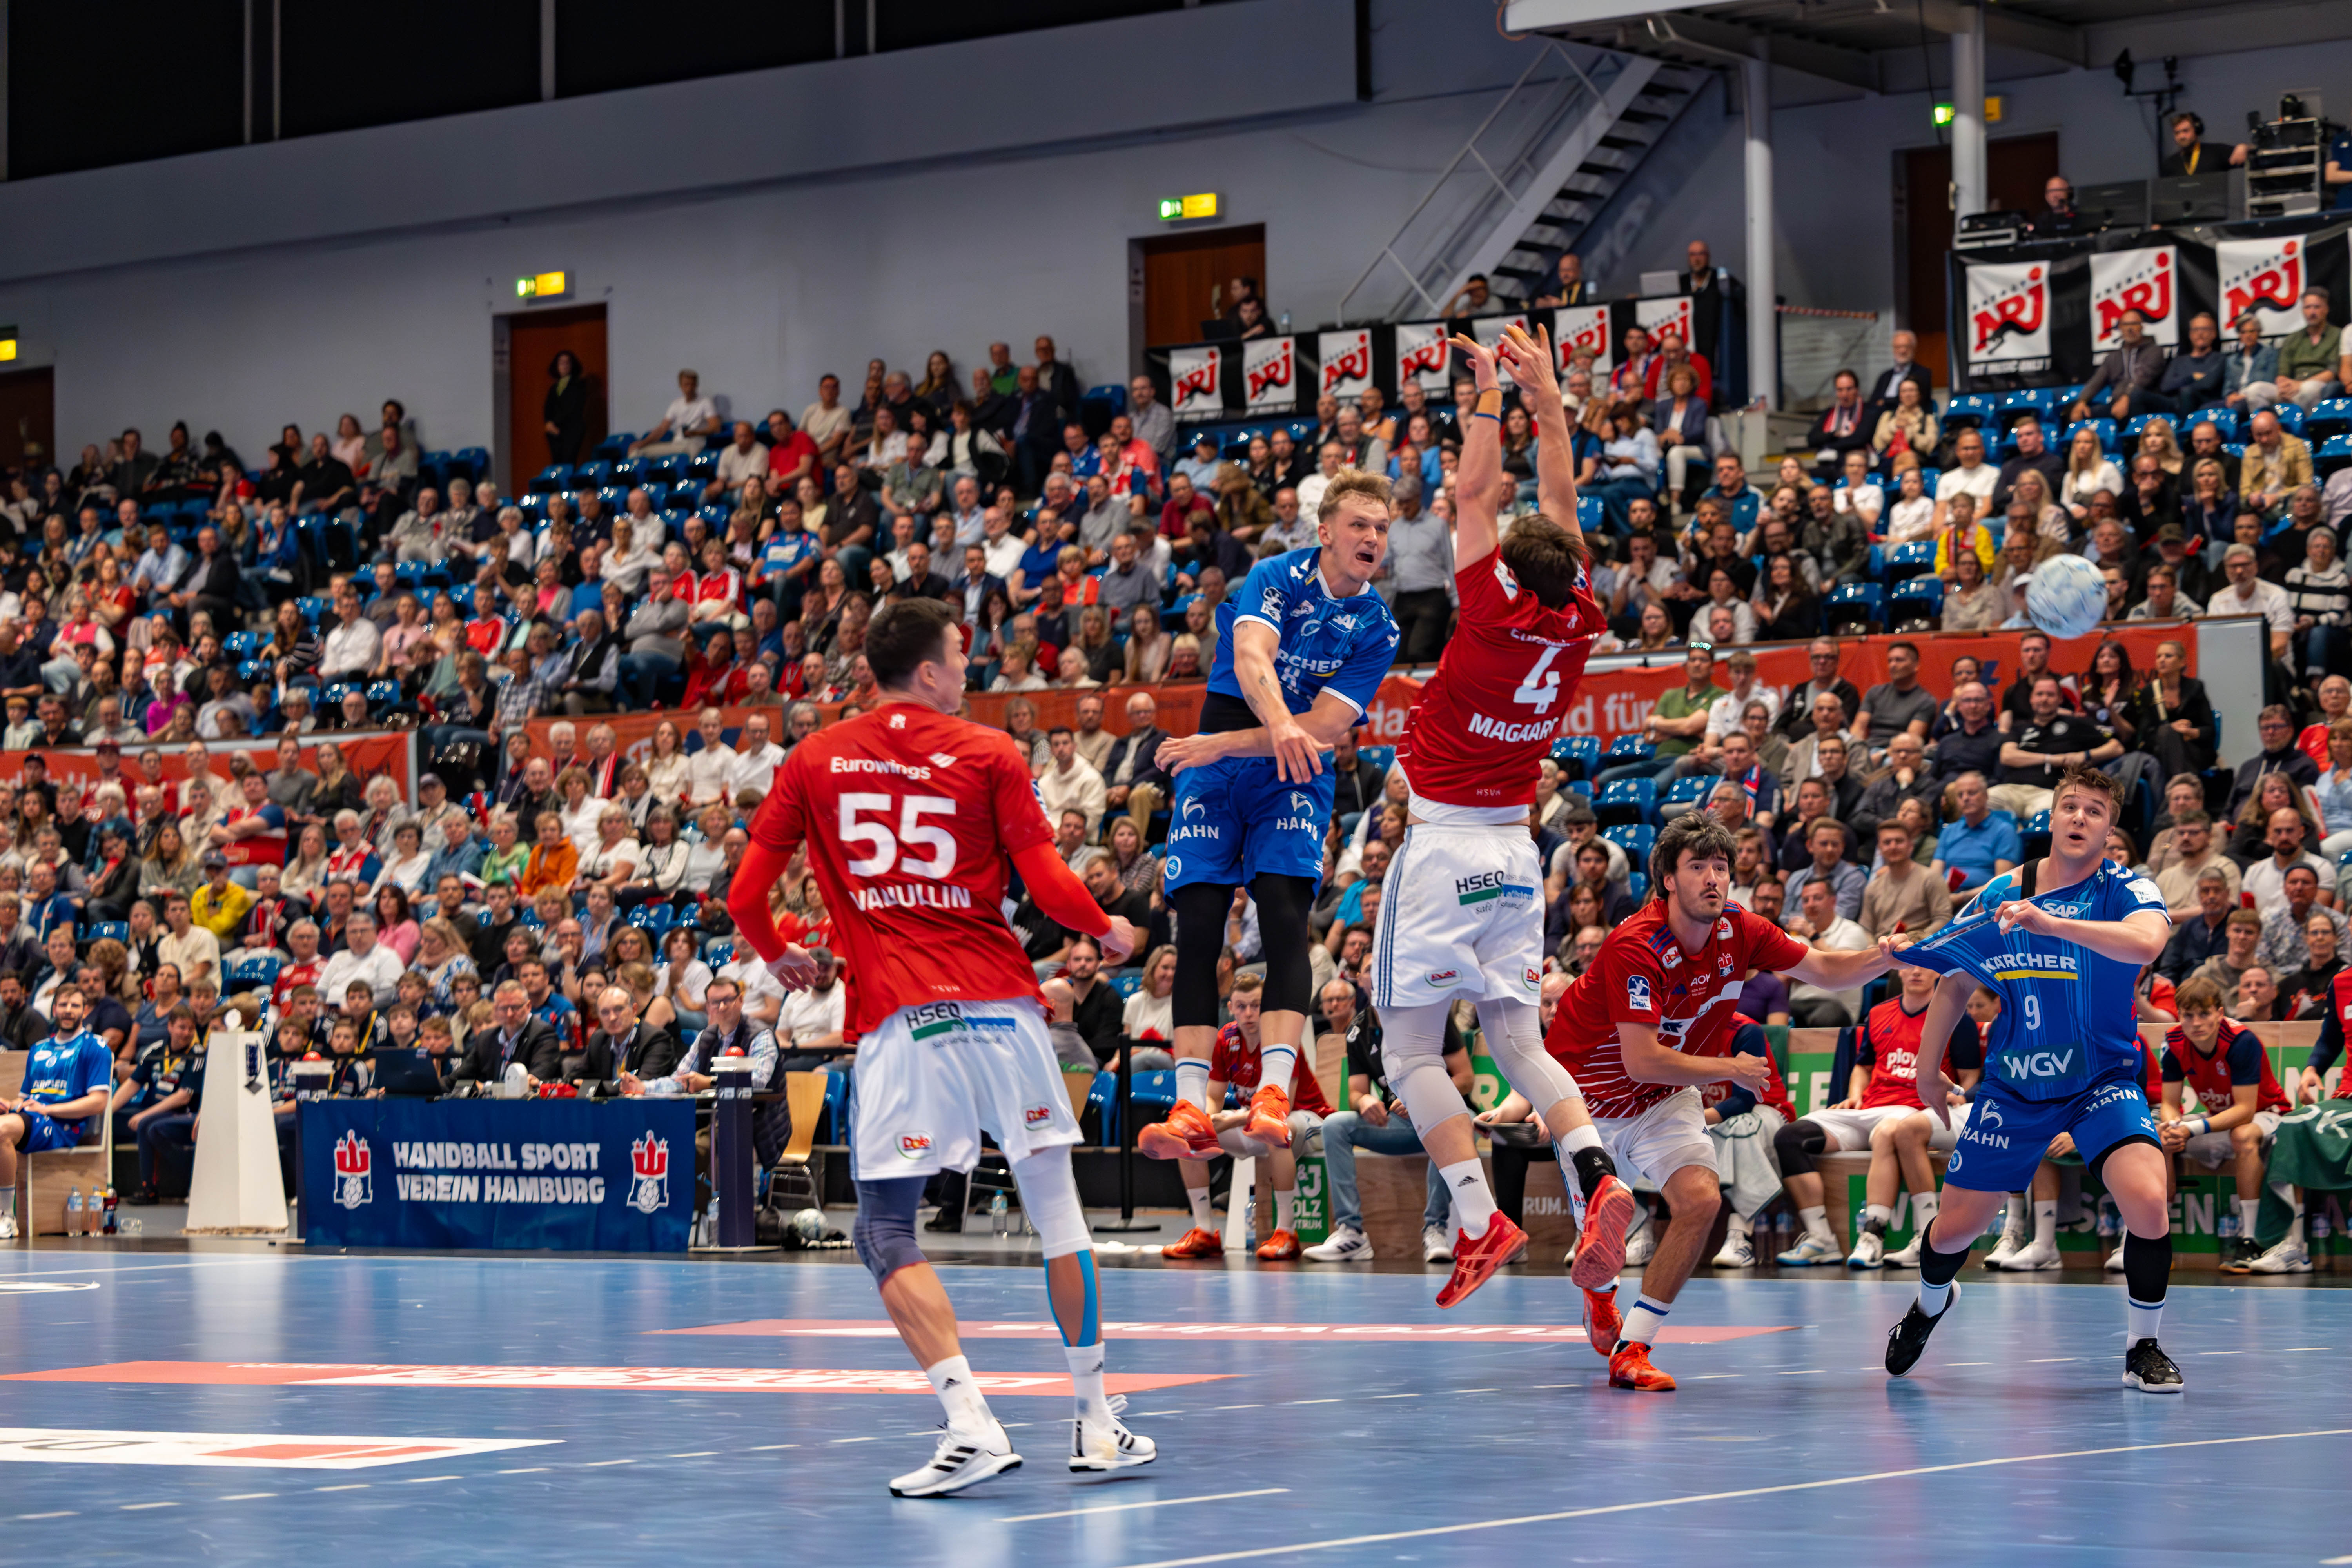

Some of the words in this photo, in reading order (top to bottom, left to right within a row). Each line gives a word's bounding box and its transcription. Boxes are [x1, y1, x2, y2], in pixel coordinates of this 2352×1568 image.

[1514, 646, 1562, 714] 4
[830, 756, 931, 780] Eurowings
[838, 793, 956, 879] 55
[1170, 825, 1219, 844] HAHN
[2043, 902, 2078, 918] SAP
[1979, 953, 2077, 974] KÄRCHER
[2025, 995, 2042, 1030] 9
[2004, 1048, 2073, 1080] WGV
[902, 1136, 931, 1149] Dole
[1960, 1125, 2010, 1149] HAHN
[393, 1142, 517, 1169] HANDBALL
[521, 1143, 600, 1171] SPORT
[396, 1174, 479, 1202] VEREIN
[484, 1176, 605, 1204] HAMBURG
[1294, 1199, 1321, 1218] OLZ
